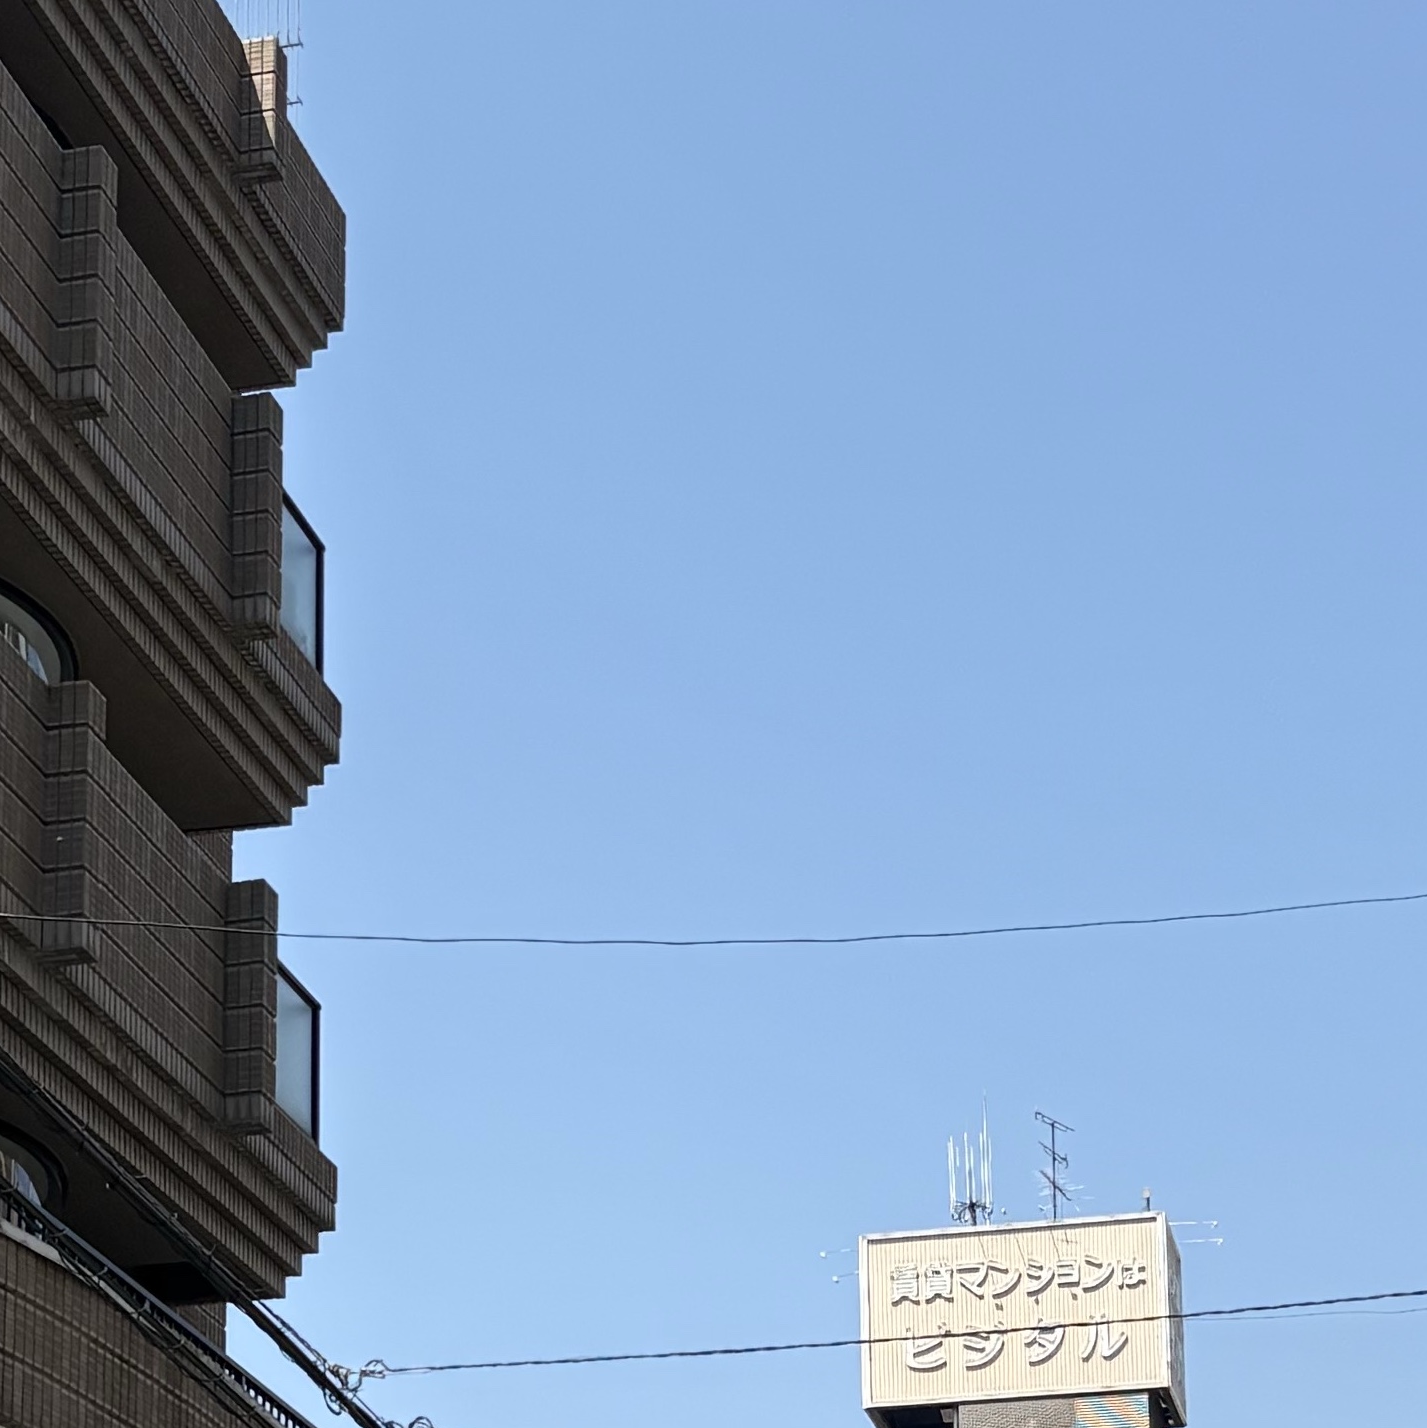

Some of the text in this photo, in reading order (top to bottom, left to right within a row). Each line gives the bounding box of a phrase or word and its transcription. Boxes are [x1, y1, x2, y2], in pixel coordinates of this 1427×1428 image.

[890, 1254, 1148, 1306] 賃貸マンションは
